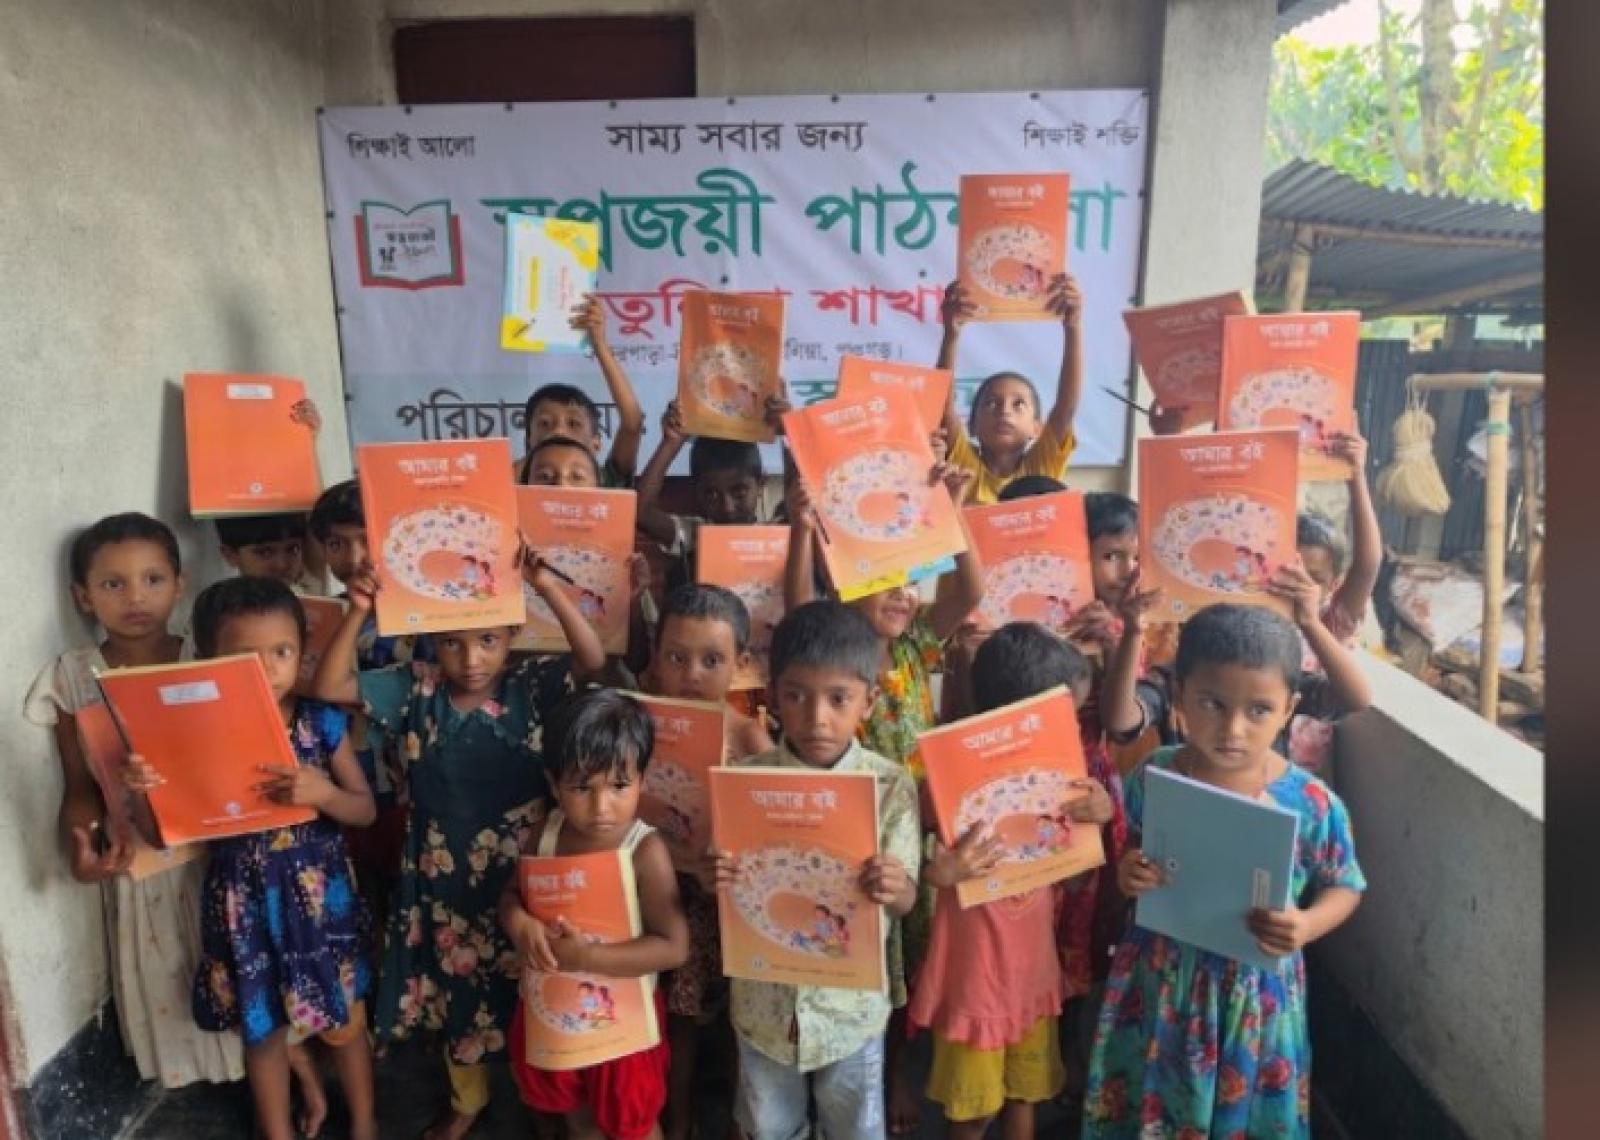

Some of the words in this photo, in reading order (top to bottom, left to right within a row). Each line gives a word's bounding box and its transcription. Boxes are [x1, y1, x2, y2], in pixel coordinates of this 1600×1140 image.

[346, 132, 412, 160] শিক্ষাই
[416, 135, 476, 158] আলো
[605, 121, 687, 154] সাম্য
[696, 119, 784, 152] সবার
[795, 119, 868, 152] জন্য
[1021, 118, 1088, 148] শিক্ষাই
[808, 283, 945, 327] শাখা
